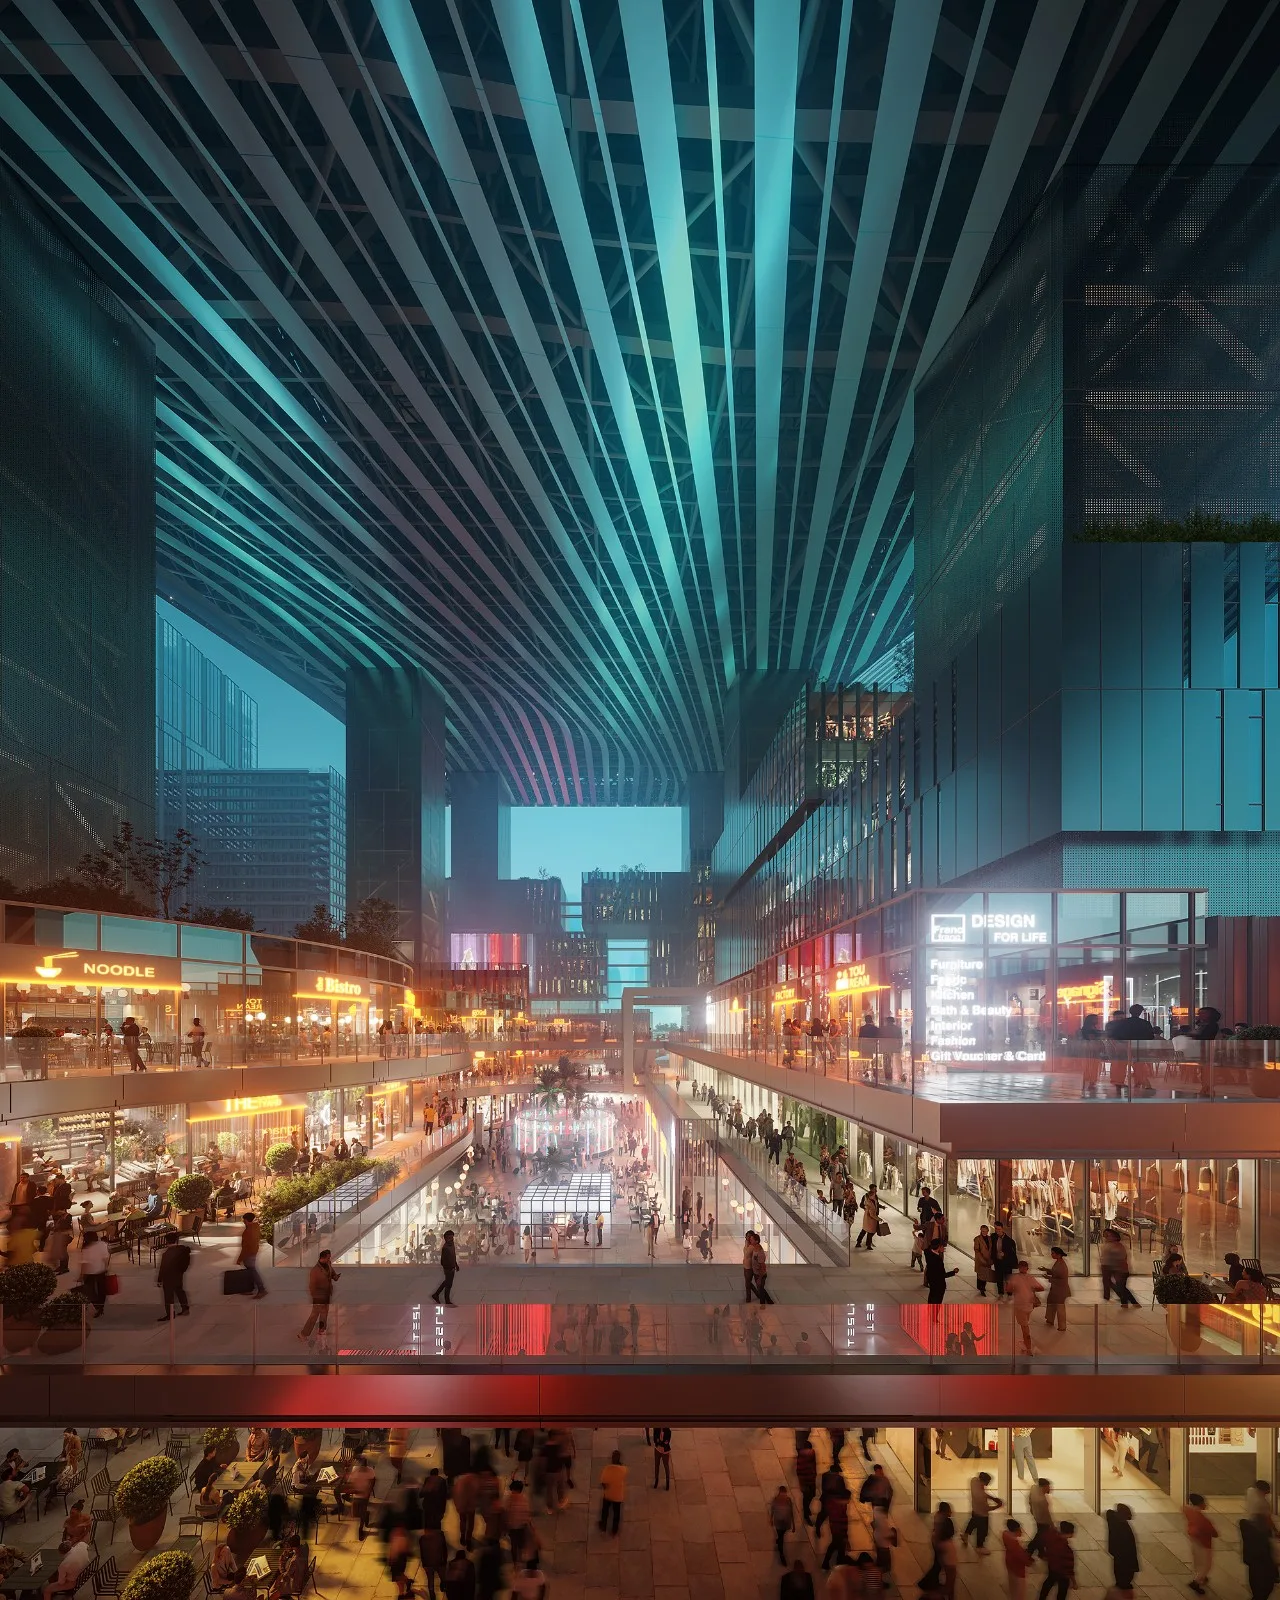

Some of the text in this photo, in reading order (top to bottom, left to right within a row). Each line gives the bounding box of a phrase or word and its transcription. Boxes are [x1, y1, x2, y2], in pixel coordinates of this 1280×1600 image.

[971, 914, 1036, 928] DESIGN
[994, 932, 1047, 943] FOR LIFE
[83, 963, 155, 978] NOODLE
[324, 977, 362, 996] Bistro
[930, 989, 975, 1000] Kitchen
[930, 1005, 958, 1016] Bath
[959, 1005, 969, 1016] &
[971, 1005, 1013, 1018] Beauty
[930, 1020, 973, 1031] Interior
[930, 1036, 977, 1046] Fashion
[930, 1051, 1046, 1061] Gift Voucher & Card
